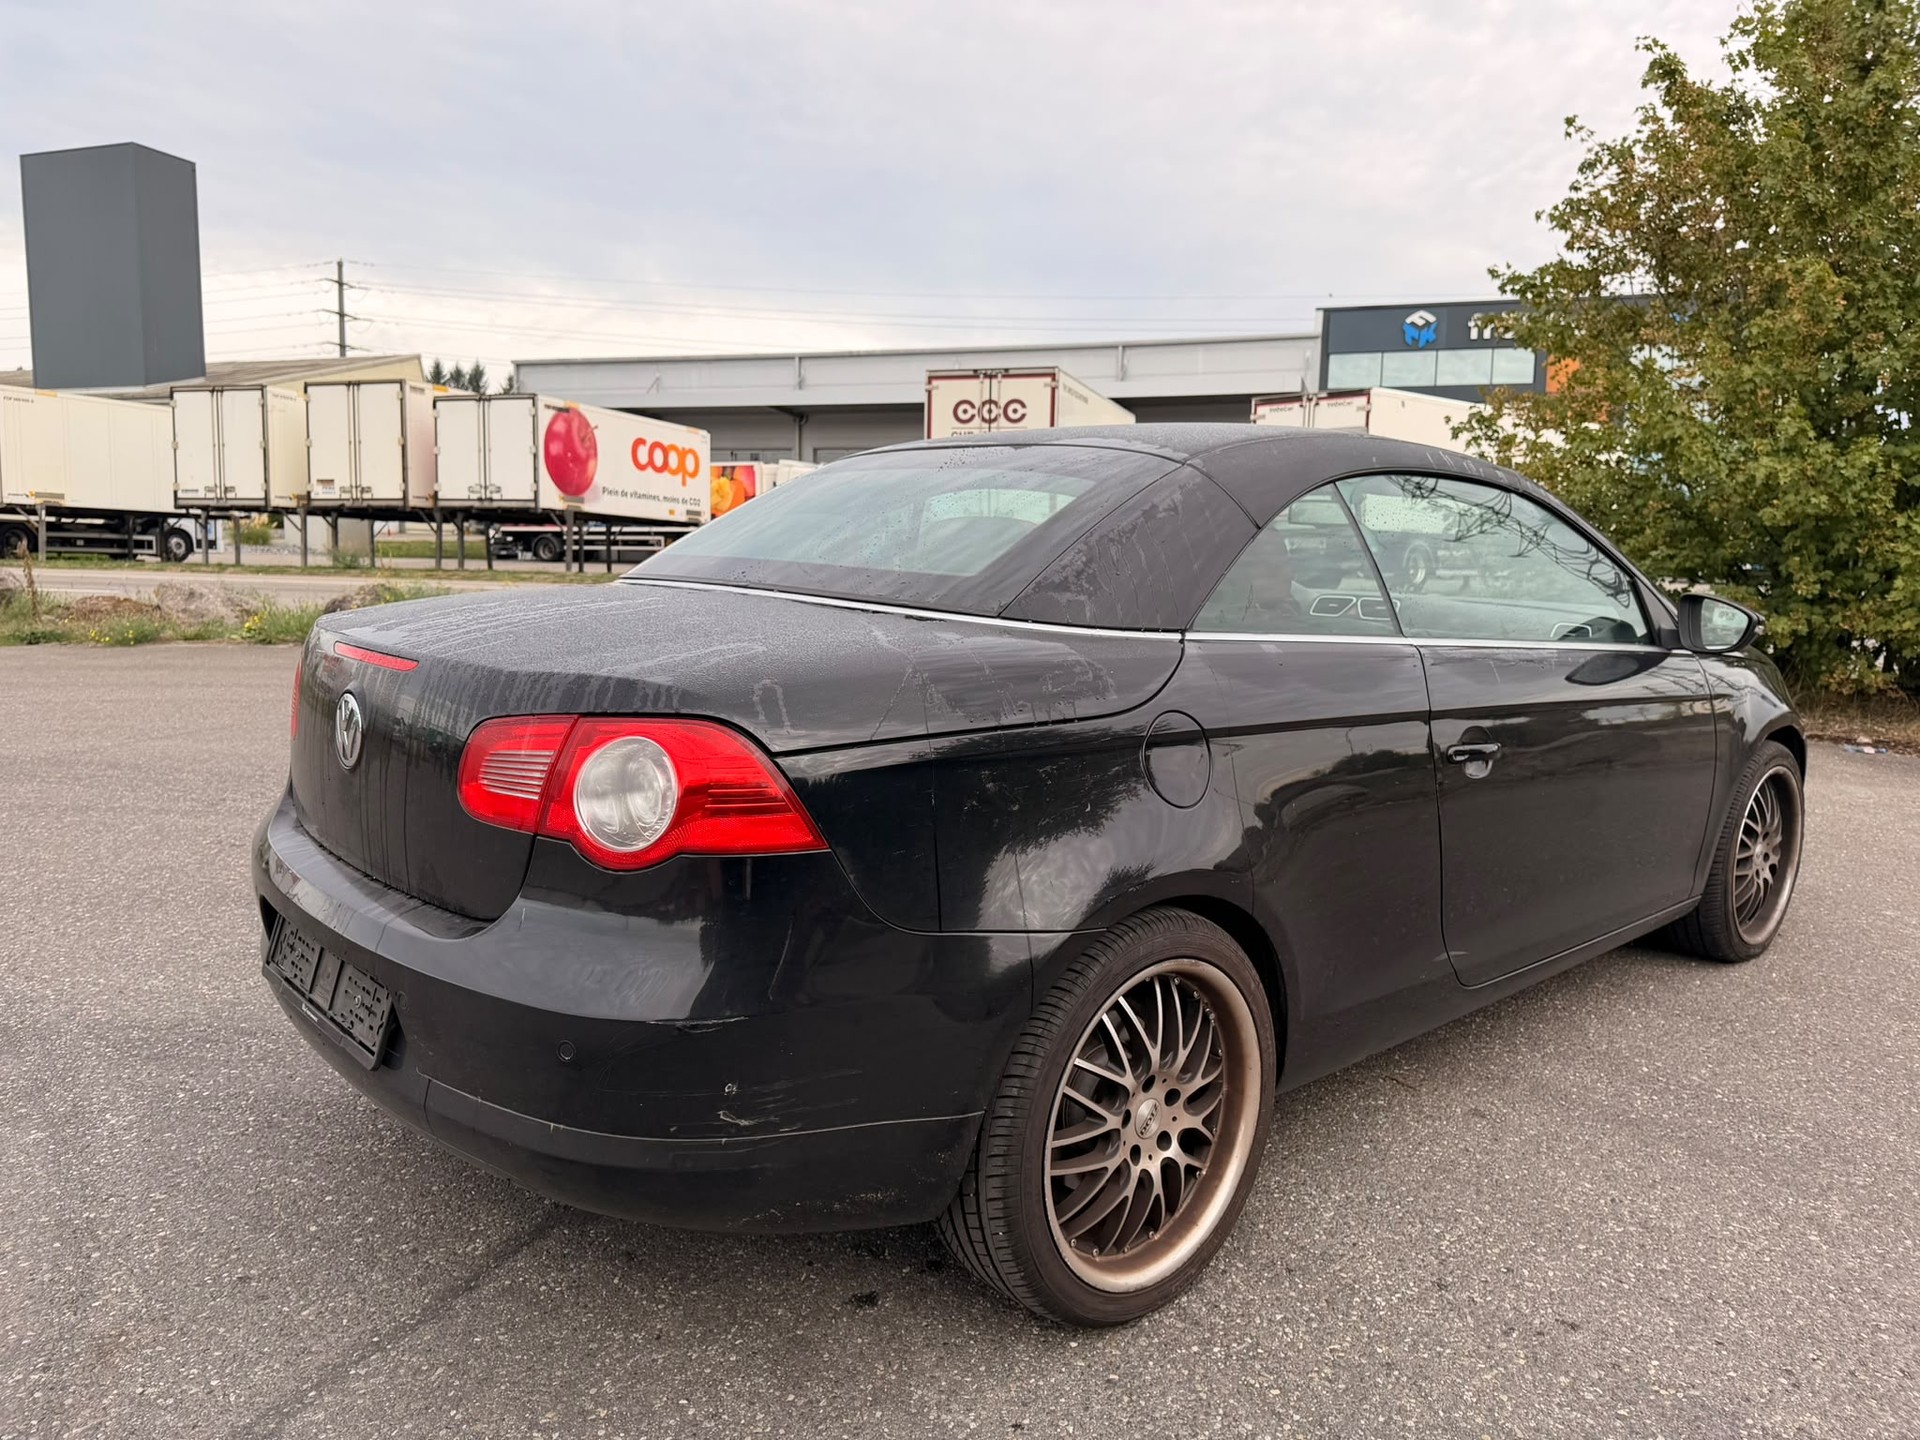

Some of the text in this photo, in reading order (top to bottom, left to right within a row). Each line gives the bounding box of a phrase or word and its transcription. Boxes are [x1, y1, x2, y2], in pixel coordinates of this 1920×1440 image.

[631, 437, 700, 487] coop
[602, 486, 702, 507] Plein de vitamines, moins de CO2
